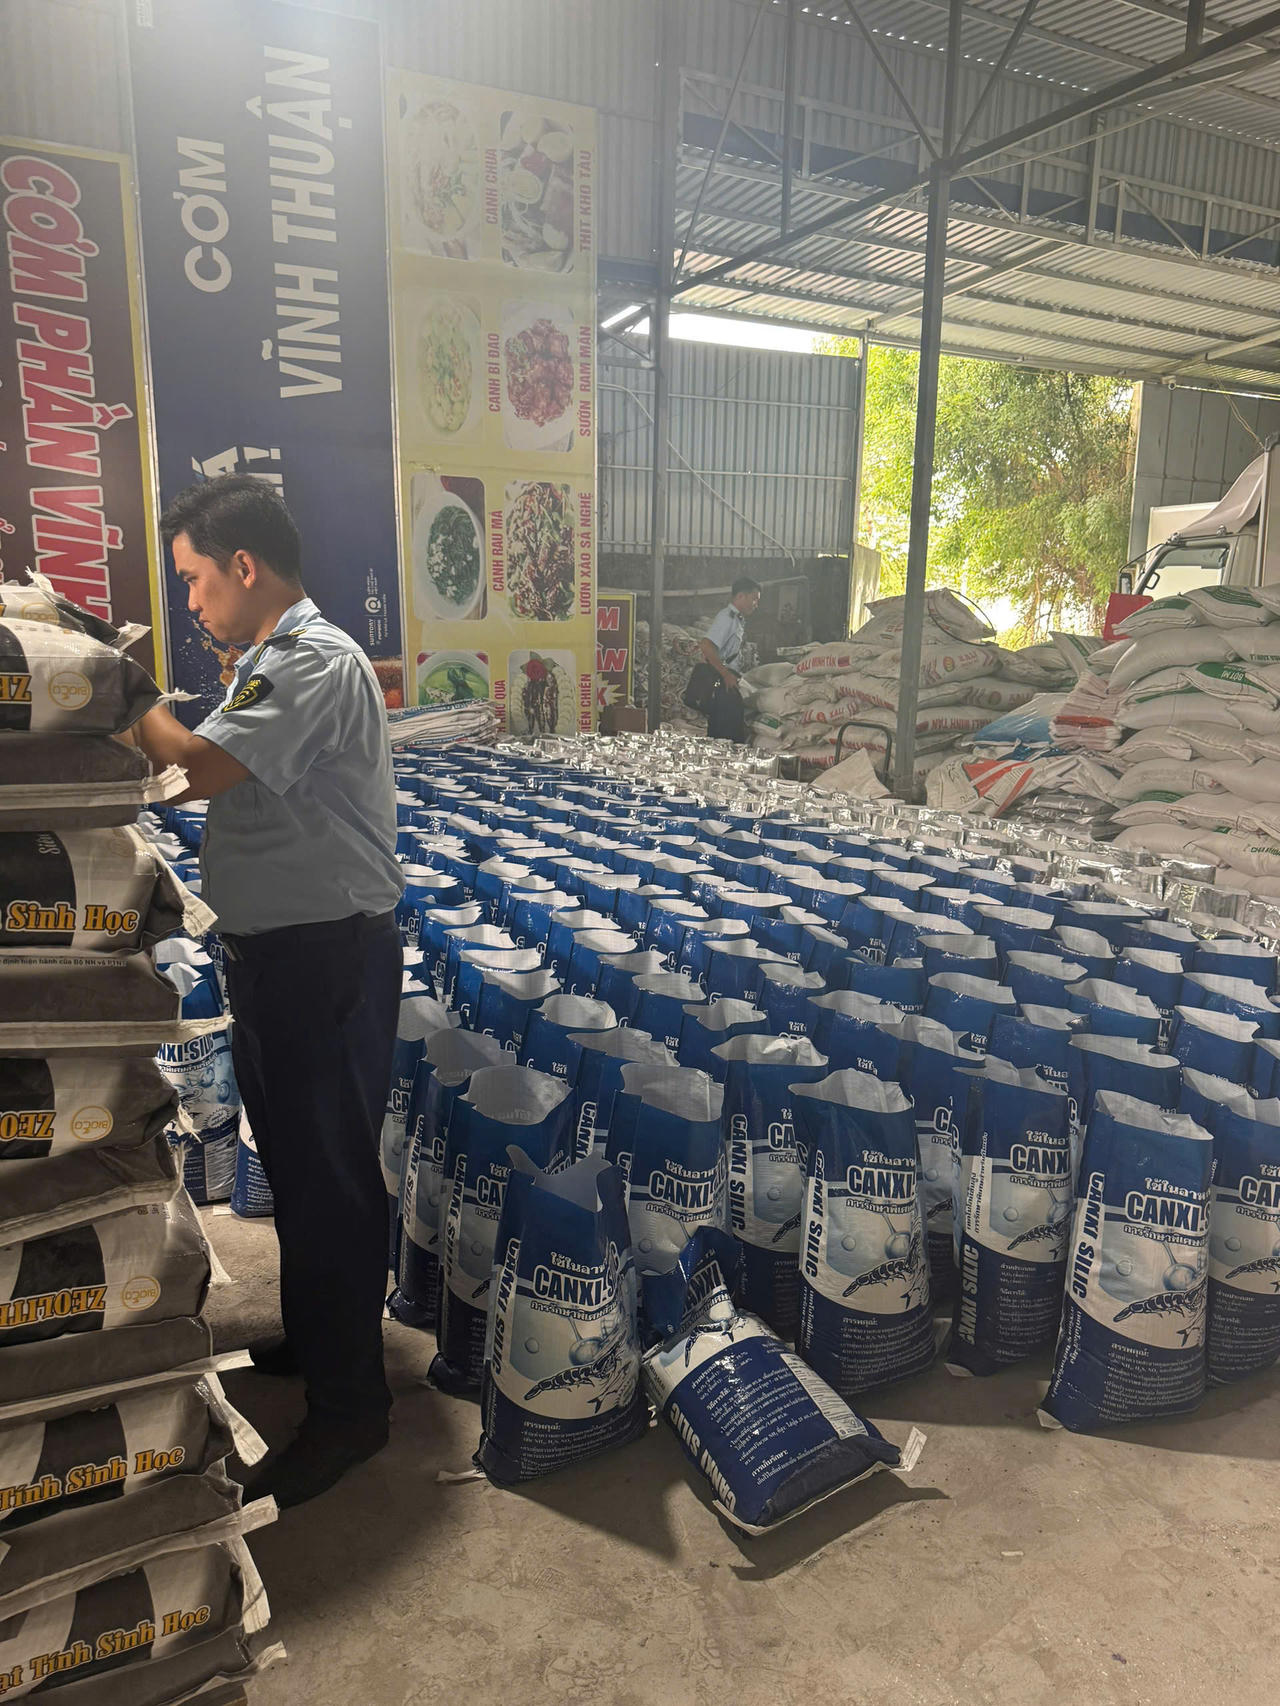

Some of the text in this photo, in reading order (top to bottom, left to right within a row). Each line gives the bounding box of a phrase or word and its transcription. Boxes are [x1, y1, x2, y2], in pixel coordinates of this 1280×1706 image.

[245, 45, 353, 244] THUẬN
[485, 148, 498, 224] CANH CHUA
[580, 184, 591, 216] KHO
[173, 136, 232, 293] CƠM
[262, 262, 343, 399] VĨNH
[488, 333, 500, 358] ĐAO
[2, 155, 133, 622] CƠM PHẦN VĨNH
[488, 378, 500, 413] CANH
[580, 362, 591, 392] RAM
[491, 533, 503, 556] RAU
[492, 560, 504, 592] CANH
[494, 680, 505, 700] QUA
[7, 901, 139, 935] Sinh Học
[0, 1111, 56, 1142] ZEO
[648, 1169, 711, 1210] CANXI
[730, 1114, 748, 1231] CANXI SILIC
[847, 1165, 914, 1201] CANXI
[805, 1149, 825, 1278] CANXI SILIC
[1125, 1190, 1203, 1233] CANXI
[1072, 1171, 1104, 1299] CANXI SILIC
[533, 1264, 604, 1308] CANXI
[962, 1244, 979, 1295] SILIC
[0, 1446, 186, 1512] Tính Sinh Học
[669, 1402, 736, 1513] CANXI SILIC
[30, 1641, 91, 1680] Tính
[97, 1620, 156, 1660] Sinh
[162, 1605, 211, 1637] Học
